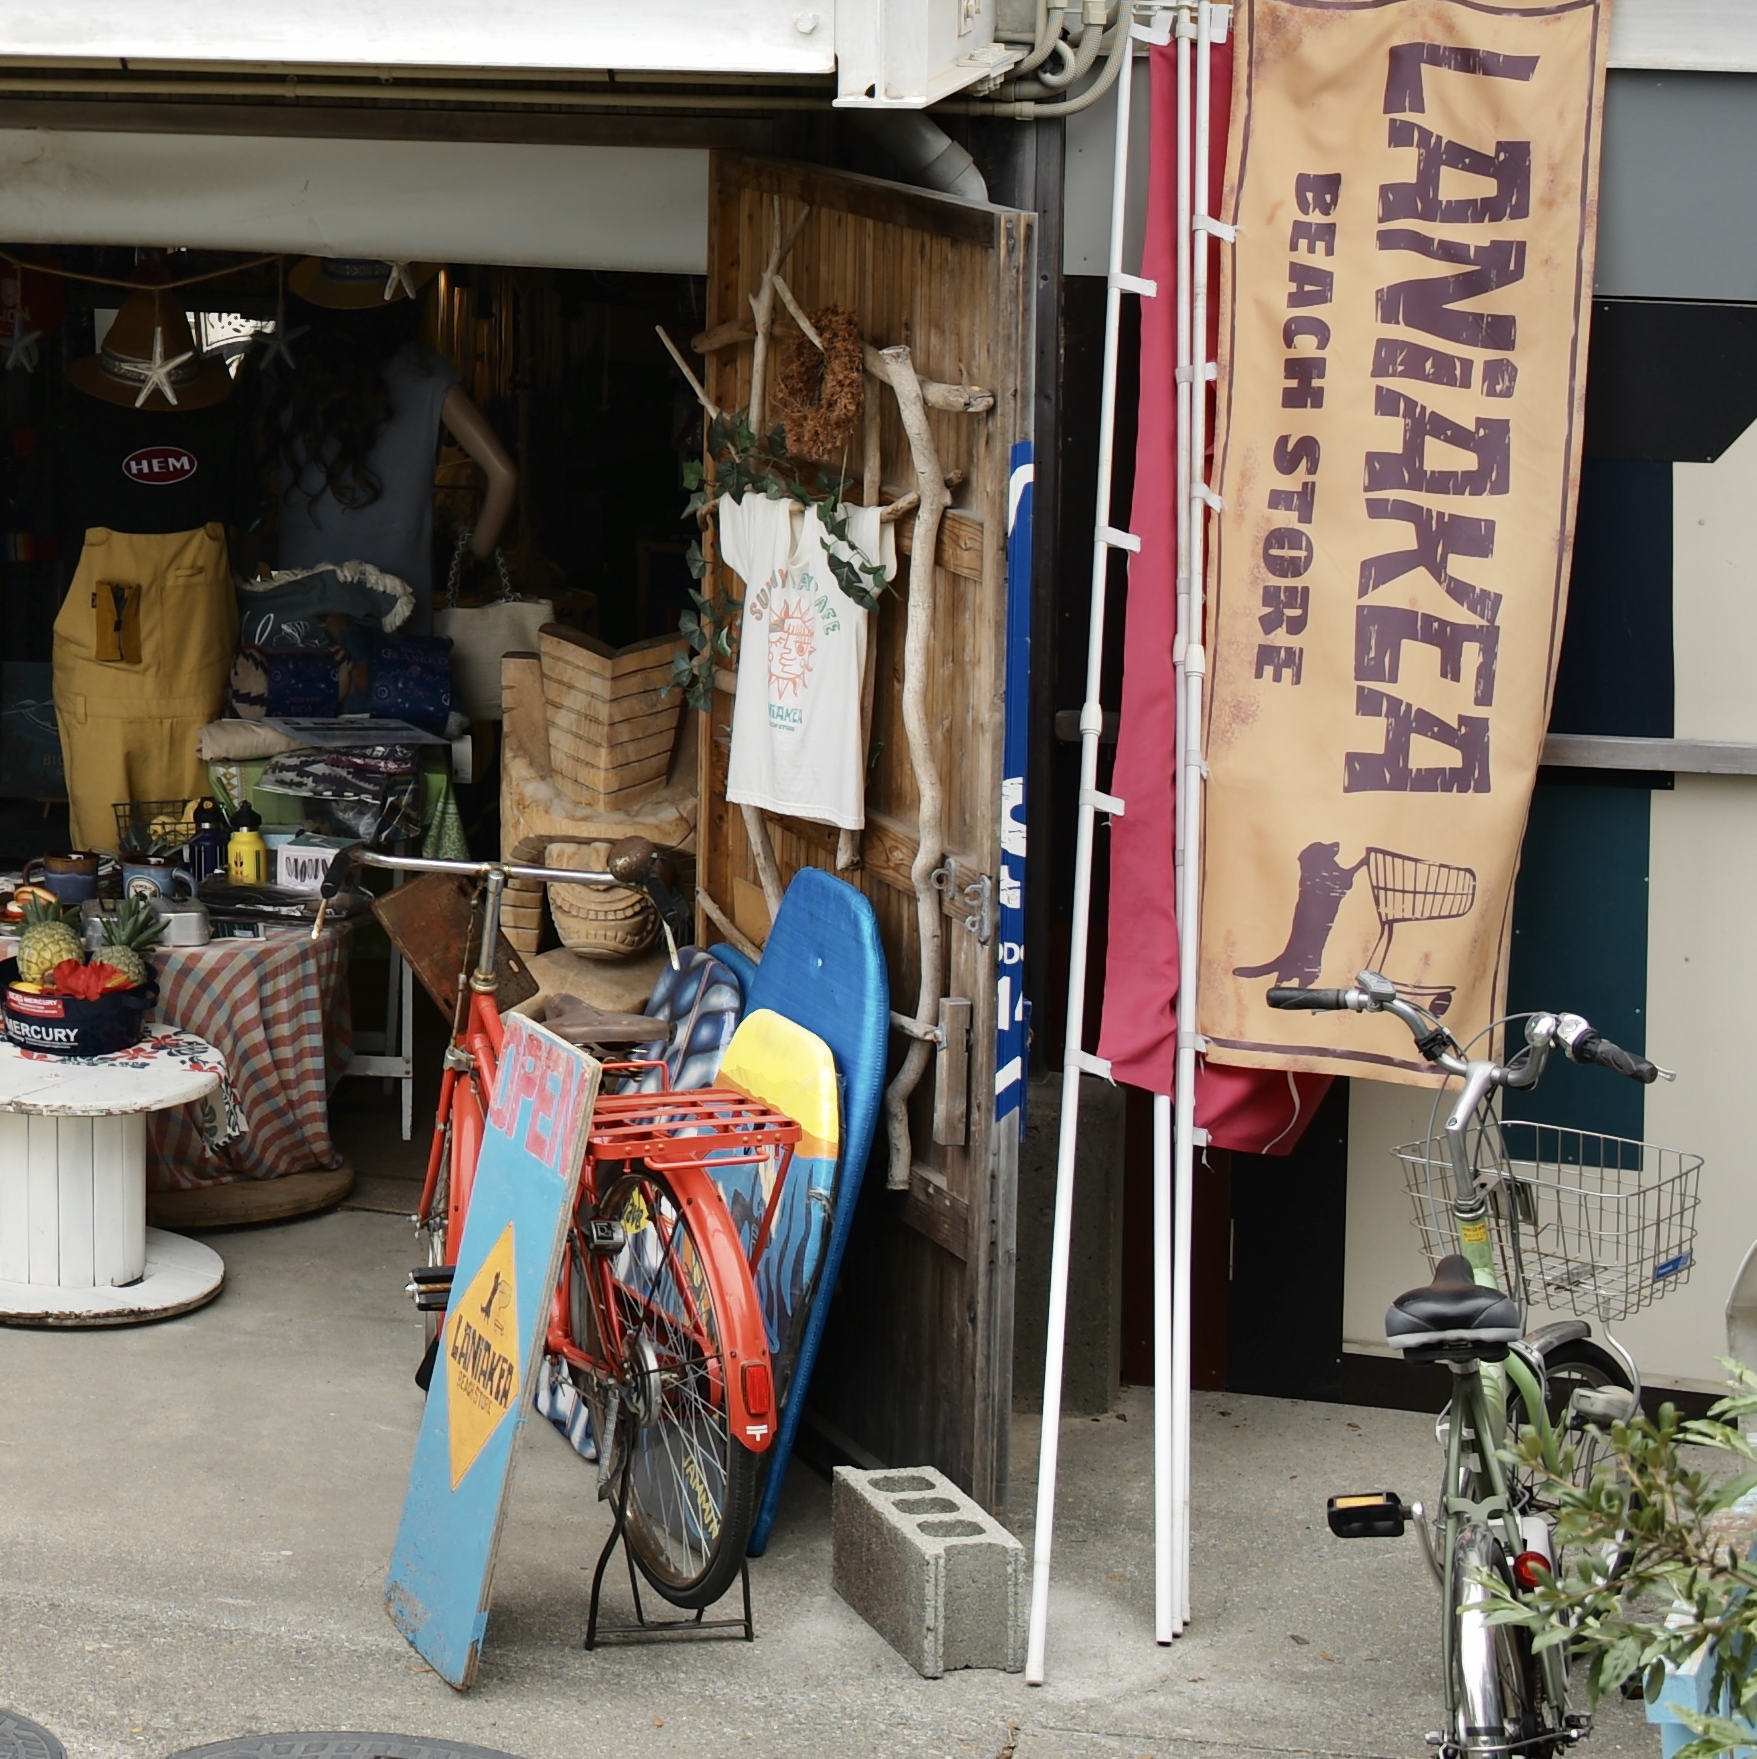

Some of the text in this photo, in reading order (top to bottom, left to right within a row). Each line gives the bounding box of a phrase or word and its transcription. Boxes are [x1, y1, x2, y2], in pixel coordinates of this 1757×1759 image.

[129, 456, 190, 474] HEM
[1253, 170, 1342, 688] BEACH STORE
[5, 1016, 79, 1043] MERCURY
[489, 1019, 589, 1181] OPEN
